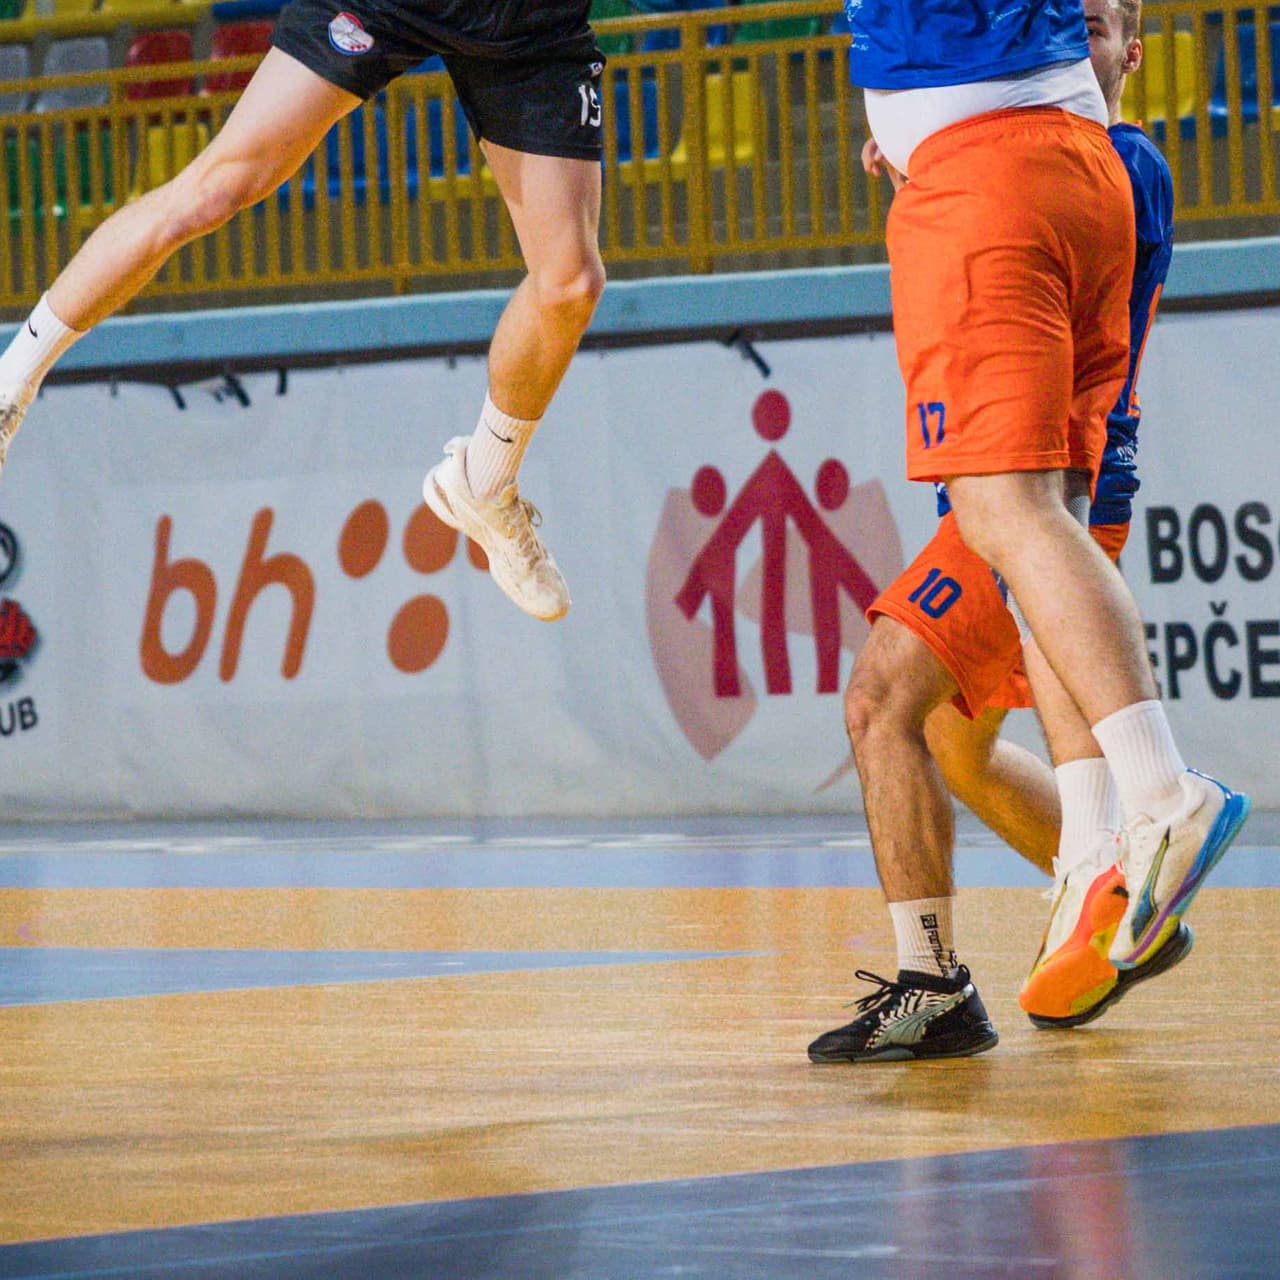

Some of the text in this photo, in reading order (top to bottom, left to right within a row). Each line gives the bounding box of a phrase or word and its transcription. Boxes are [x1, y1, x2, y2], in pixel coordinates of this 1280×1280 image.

[578, 83, 601, 129] 15
[918, 402, 945, 449] 17
[138, 506, 315, 685] bh
[908, 568, 962, 619] 10
